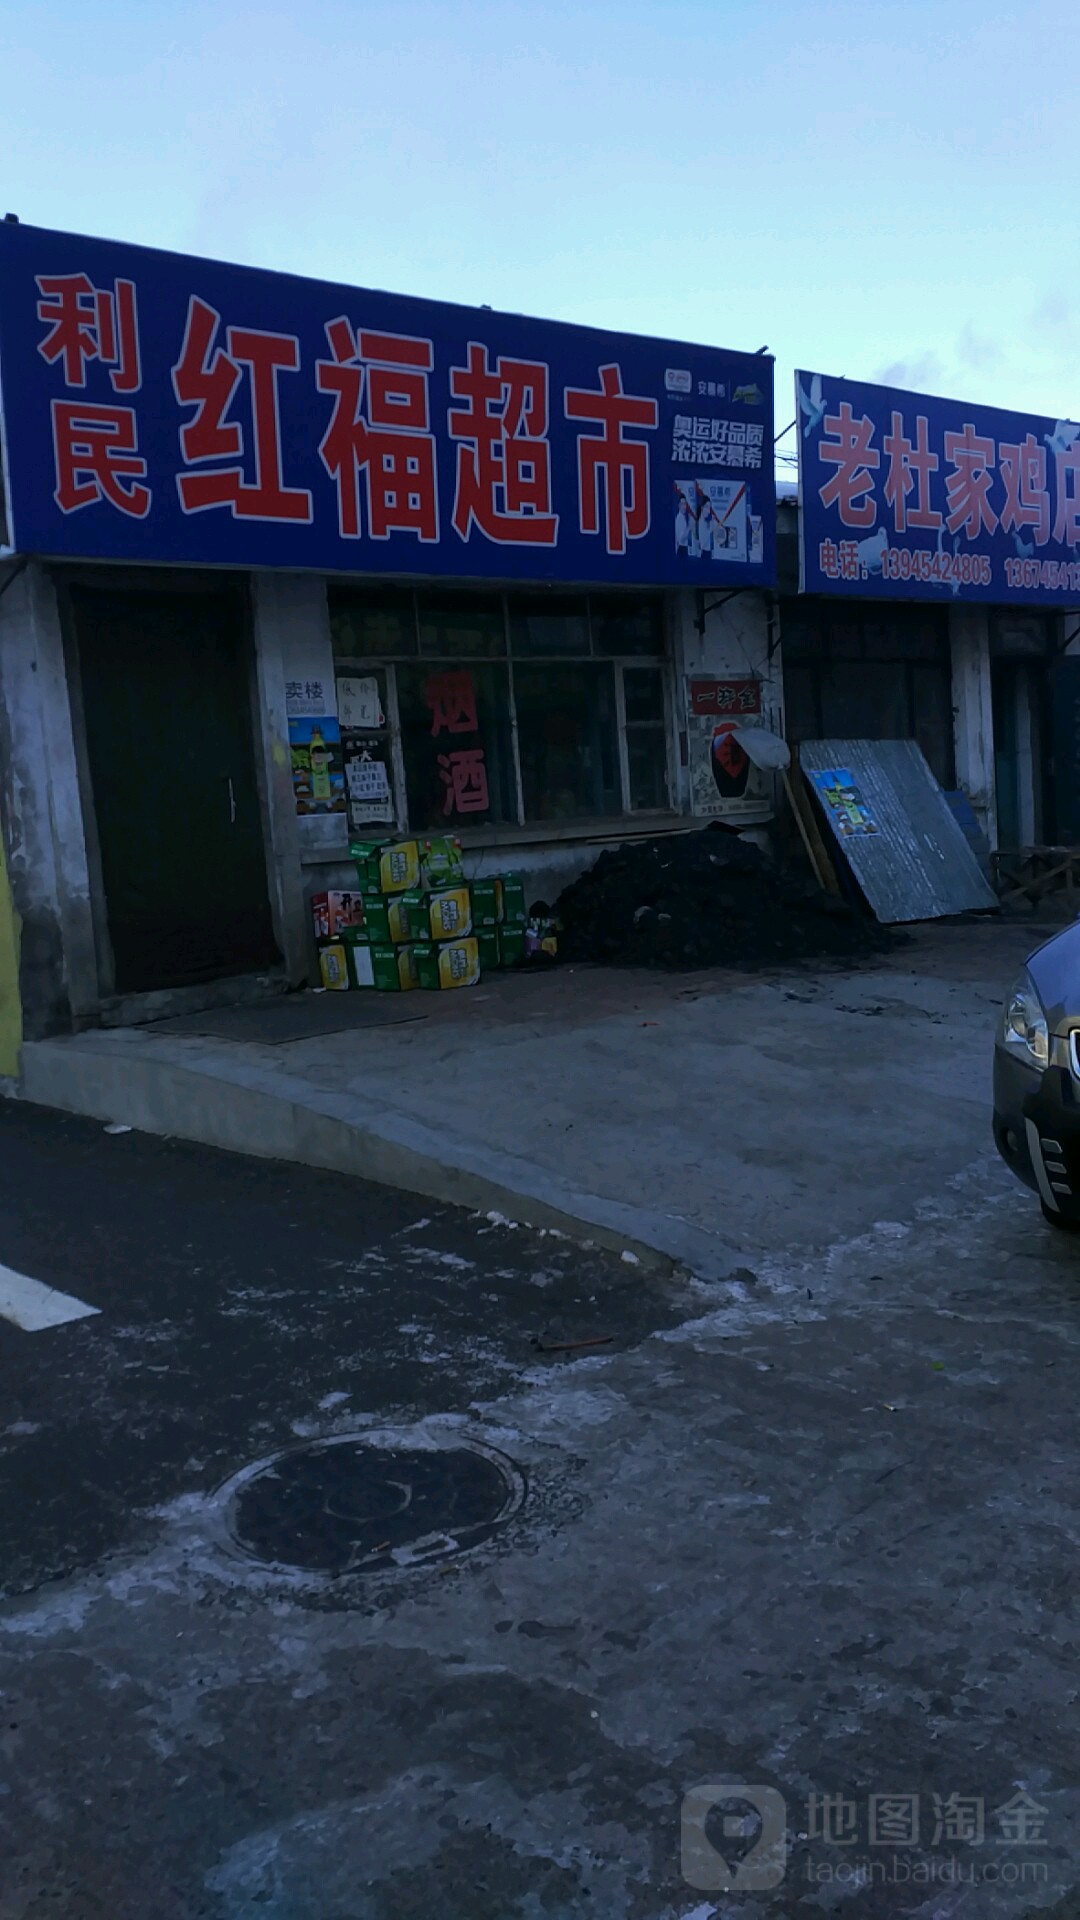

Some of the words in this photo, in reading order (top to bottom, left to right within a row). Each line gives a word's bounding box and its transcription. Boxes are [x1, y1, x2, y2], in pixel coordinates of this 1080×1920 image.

[34, 271, 152, 519] 利民
[170, 293, 660, 556] 红福超市
[672, 414, 764, 446] 奥运好品质
[671, 438, 762, 469] 浓浓安慕希
[880, 547, 992, 586] 13945424805
[285, 681, 323, 699] 卖楼
